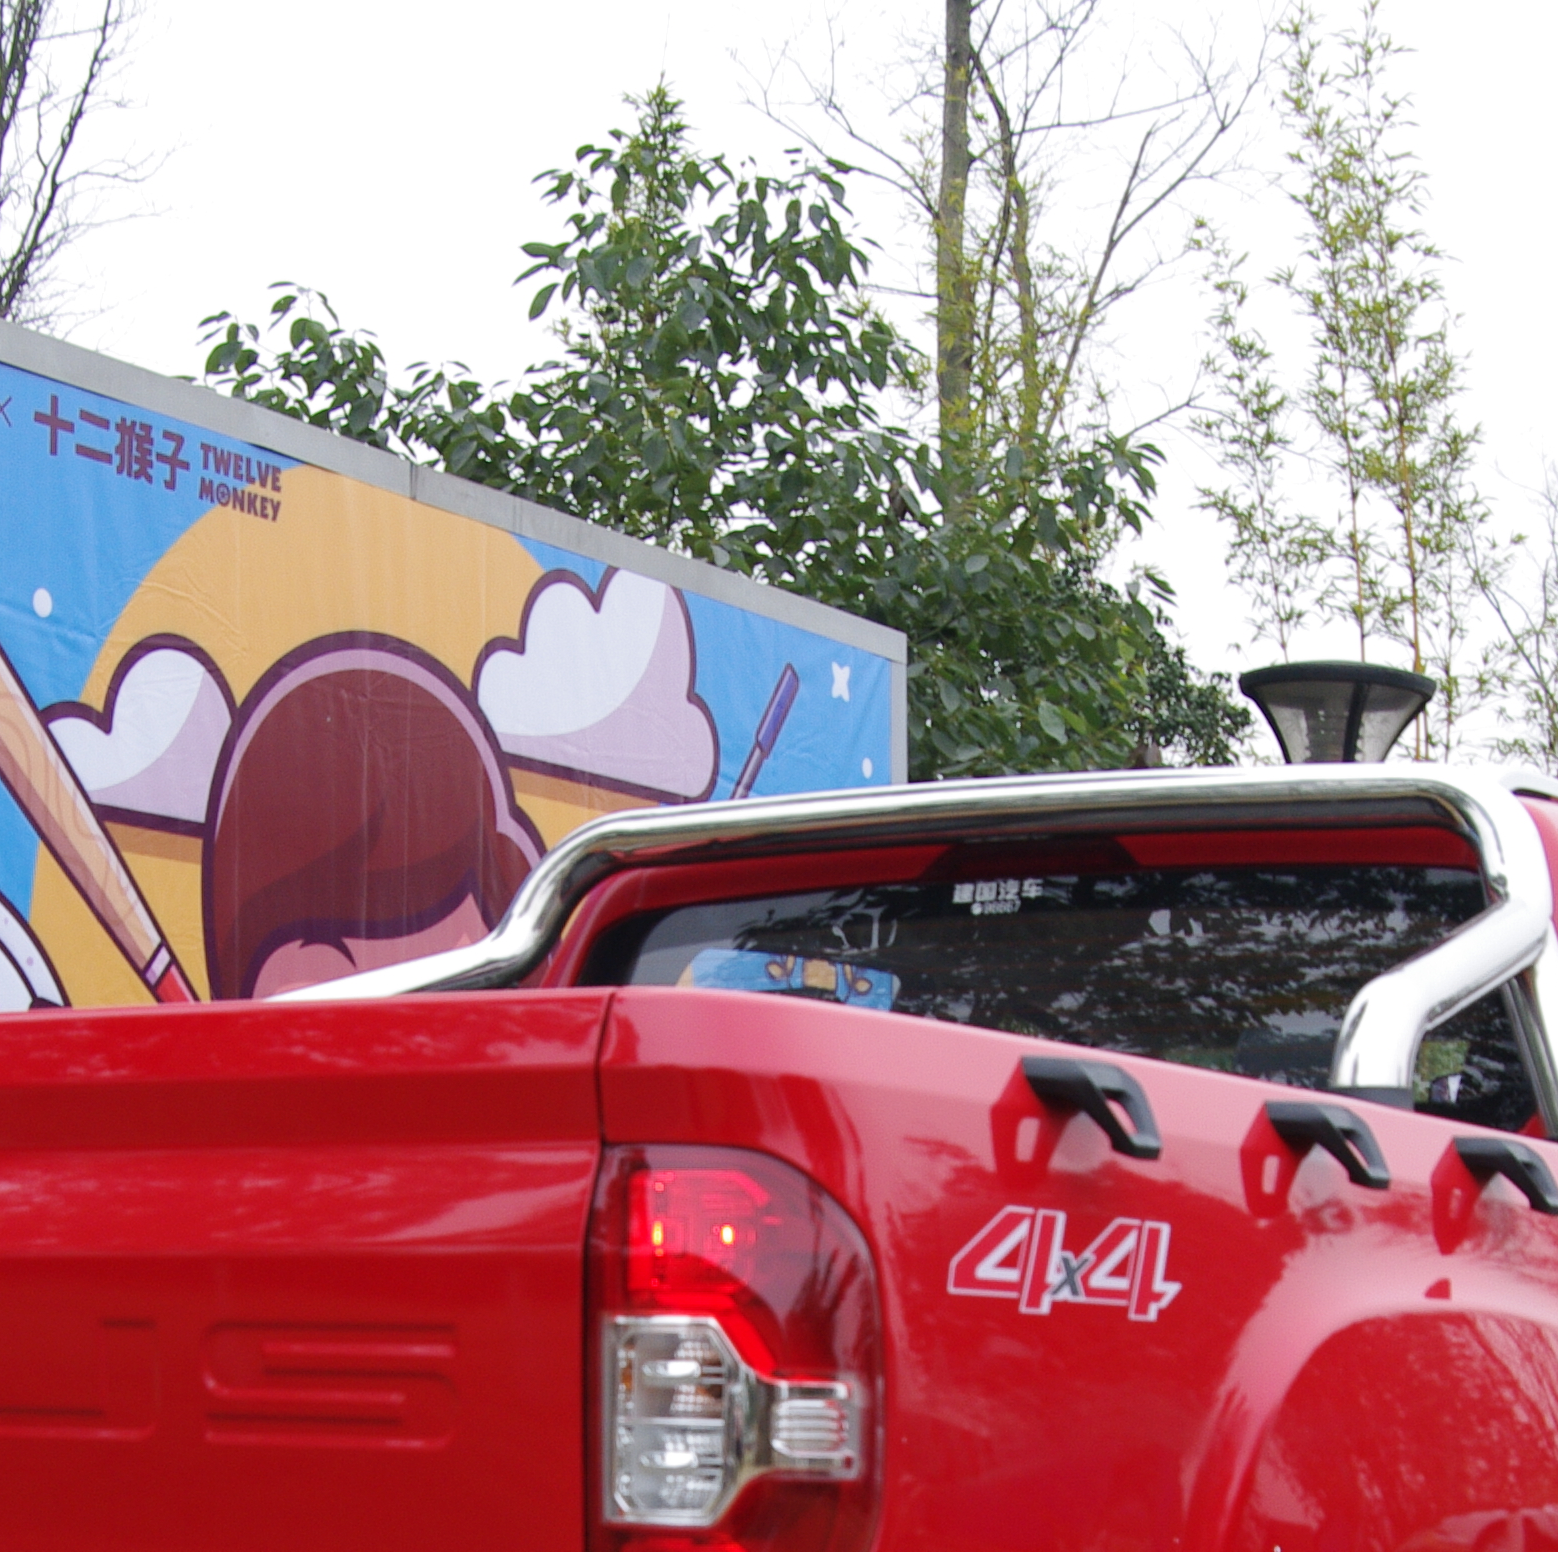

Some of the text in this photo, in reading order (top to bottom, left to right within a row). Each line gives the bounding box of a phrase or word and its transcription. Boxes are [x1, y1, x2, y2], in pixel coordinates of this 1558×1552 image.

[33, 393, 191, 492] 十二猴子
[199, 441, 282, 492] TWELVE
[198, 476, 282, 522] MONKEY
